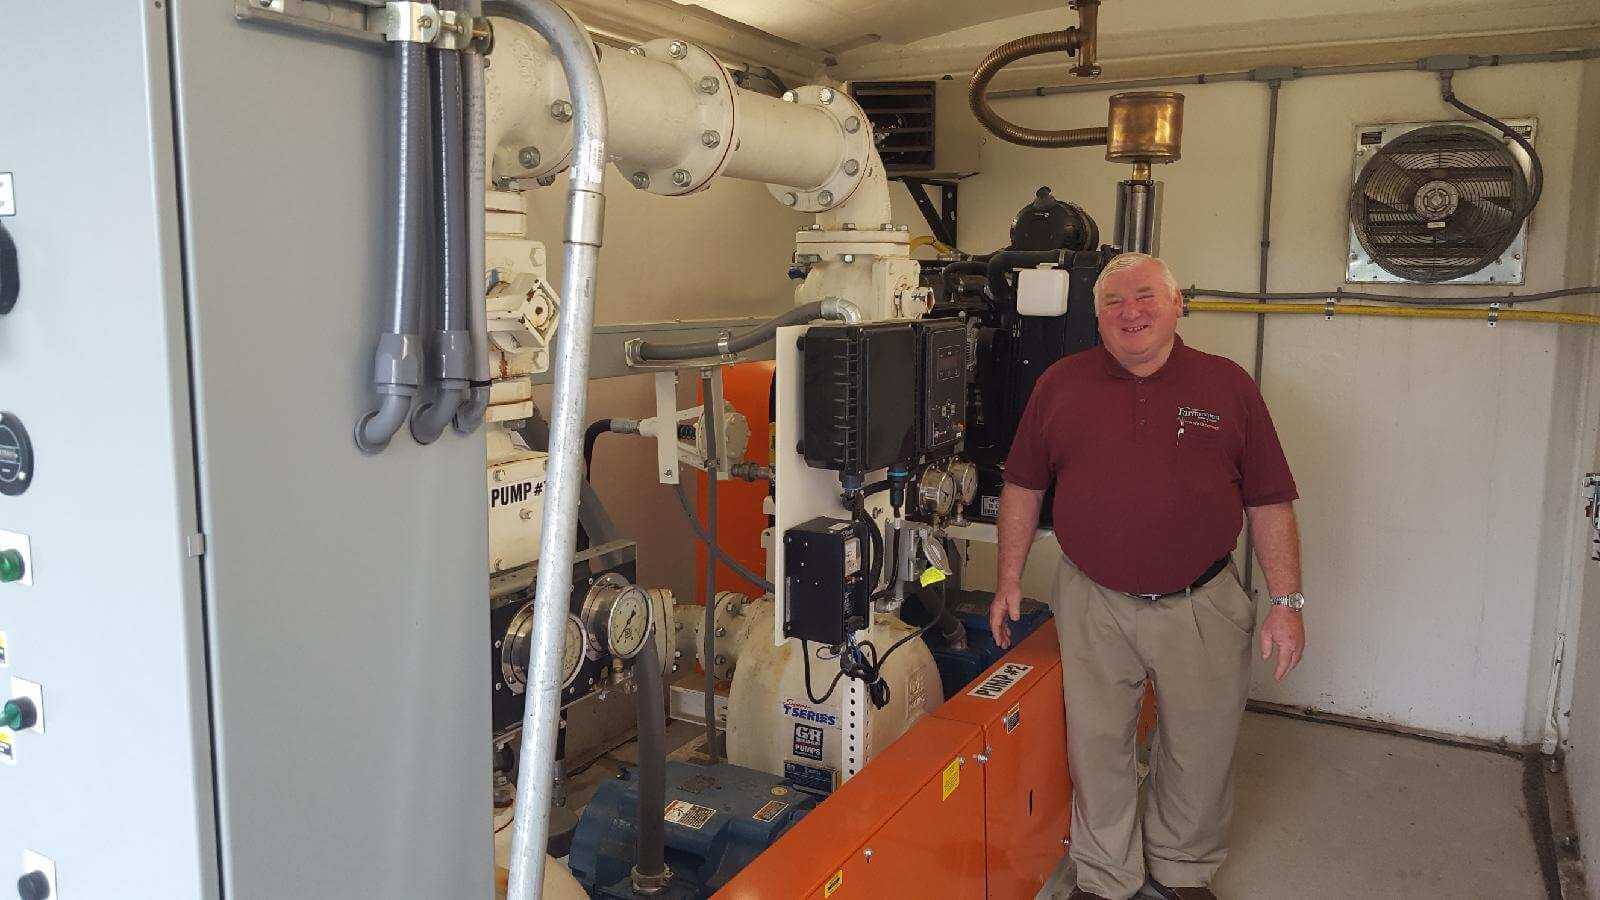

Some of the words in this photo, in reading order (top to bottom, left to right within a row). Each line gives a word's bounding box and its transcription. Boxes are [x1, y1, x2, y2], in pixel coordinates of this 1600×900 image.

[491, 482, 532, 508] PUMP
[975, 674, 1014, 697] PUMP
[1003, 664, 1029, 676] #2
